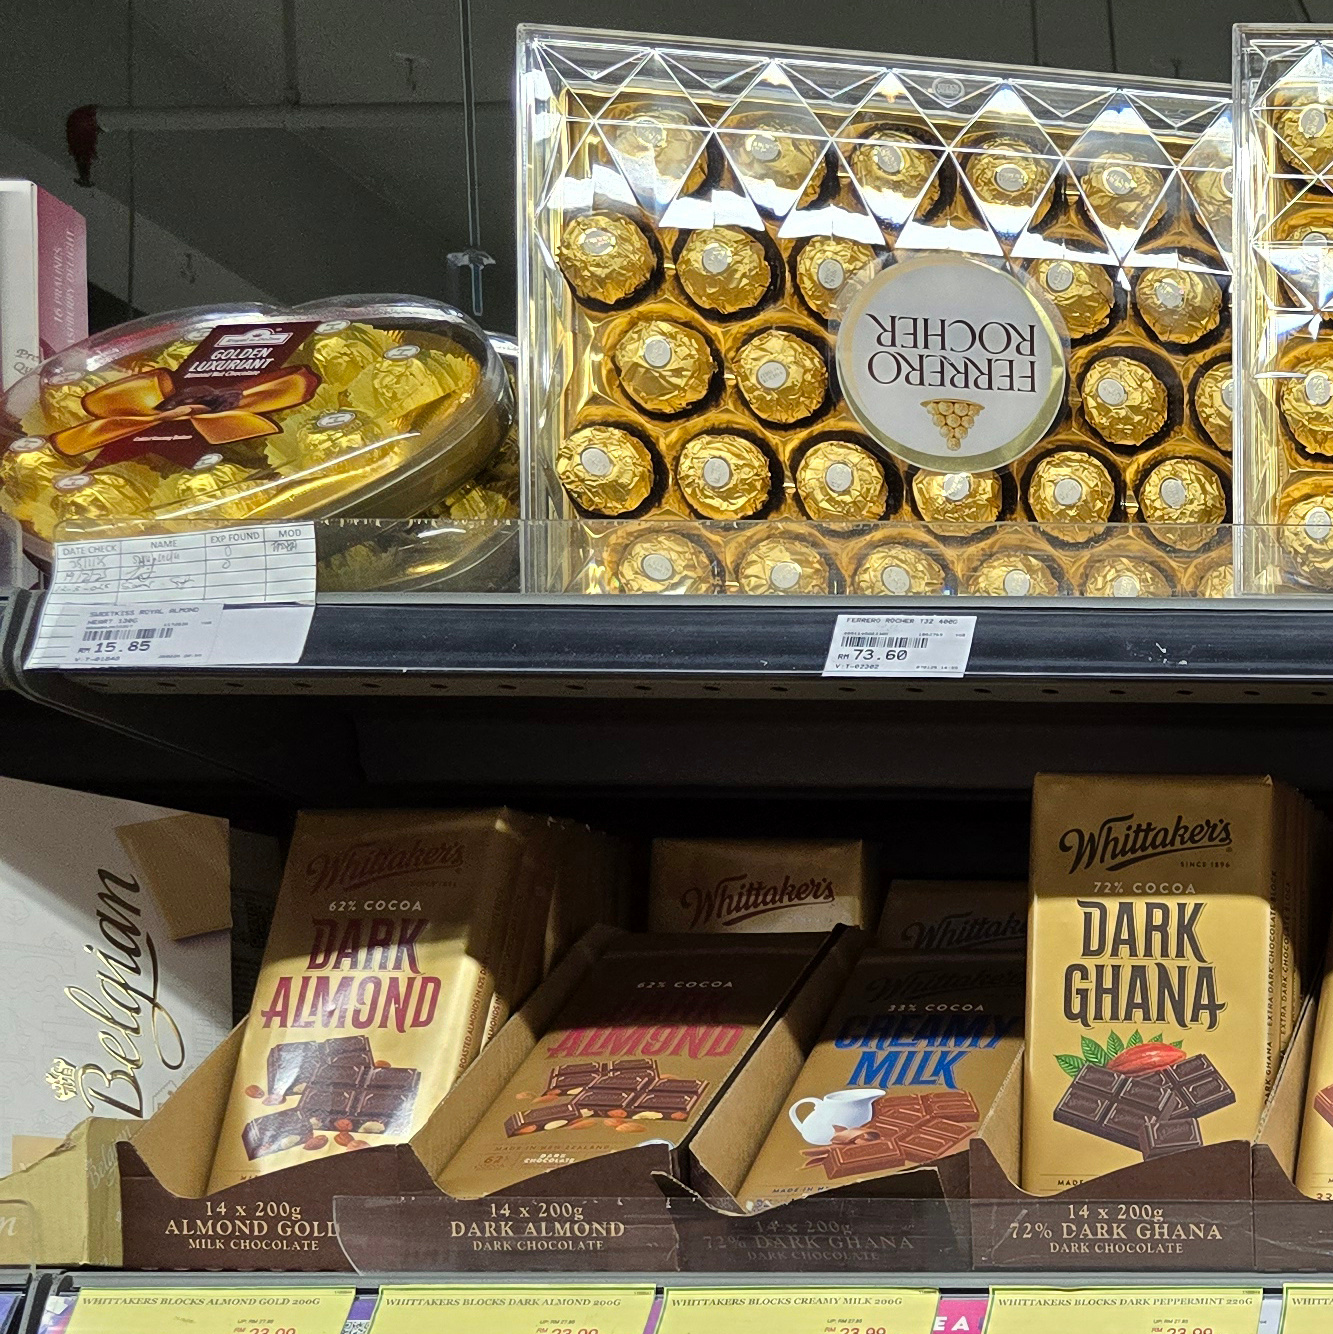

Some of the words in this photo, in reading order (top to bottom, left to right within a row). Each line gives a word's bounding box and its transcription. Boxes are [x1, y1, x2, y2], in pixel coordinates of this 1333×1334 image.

[211, 347, 270, 360] GOLDEN
[865, 313, 1036, 356] ROCHER
[188, 358, 274, 373] LUXURIANT
[867, 352, 1036, 394] FERRERO
[63, 546, 86, 556] DATE
[88, 544, 117, 555] CHECK
[151, 539, 177, 549] NAME
[210, 534, 227, 544] EXP
[229, 531, 260, 542] FOUND
[279, 528, 301, 538] MOD
[94, 640, 151, 654] 15.85
[853, 650, 908, 662] 73.60
[1059, 813, 1233, 874] Whittaker's
[306, 916, 430, 975] DARK
[1076, 900, 1209, 963] DARK
[71, 867, 186, 1119] Belgian
[262, 976, 442, 1032] ALMOND
[1064, 963, 1229, 1029] GHANA
[847, 1049, 978, 1090] MILK
[1010, 1223, 1053, 1239] 72%
[1062, 1223, 1128, 1240] DARK
[1135, 1223, 1223, 1240] GHANA
[82, 1298, 158, 1306] WHITTAKERS
[160, 1298, 205, 1306] BLOCKS
[206, 1298, 257, 1306] ALMOND
[258, 1298, 291, 1306] GOLD
